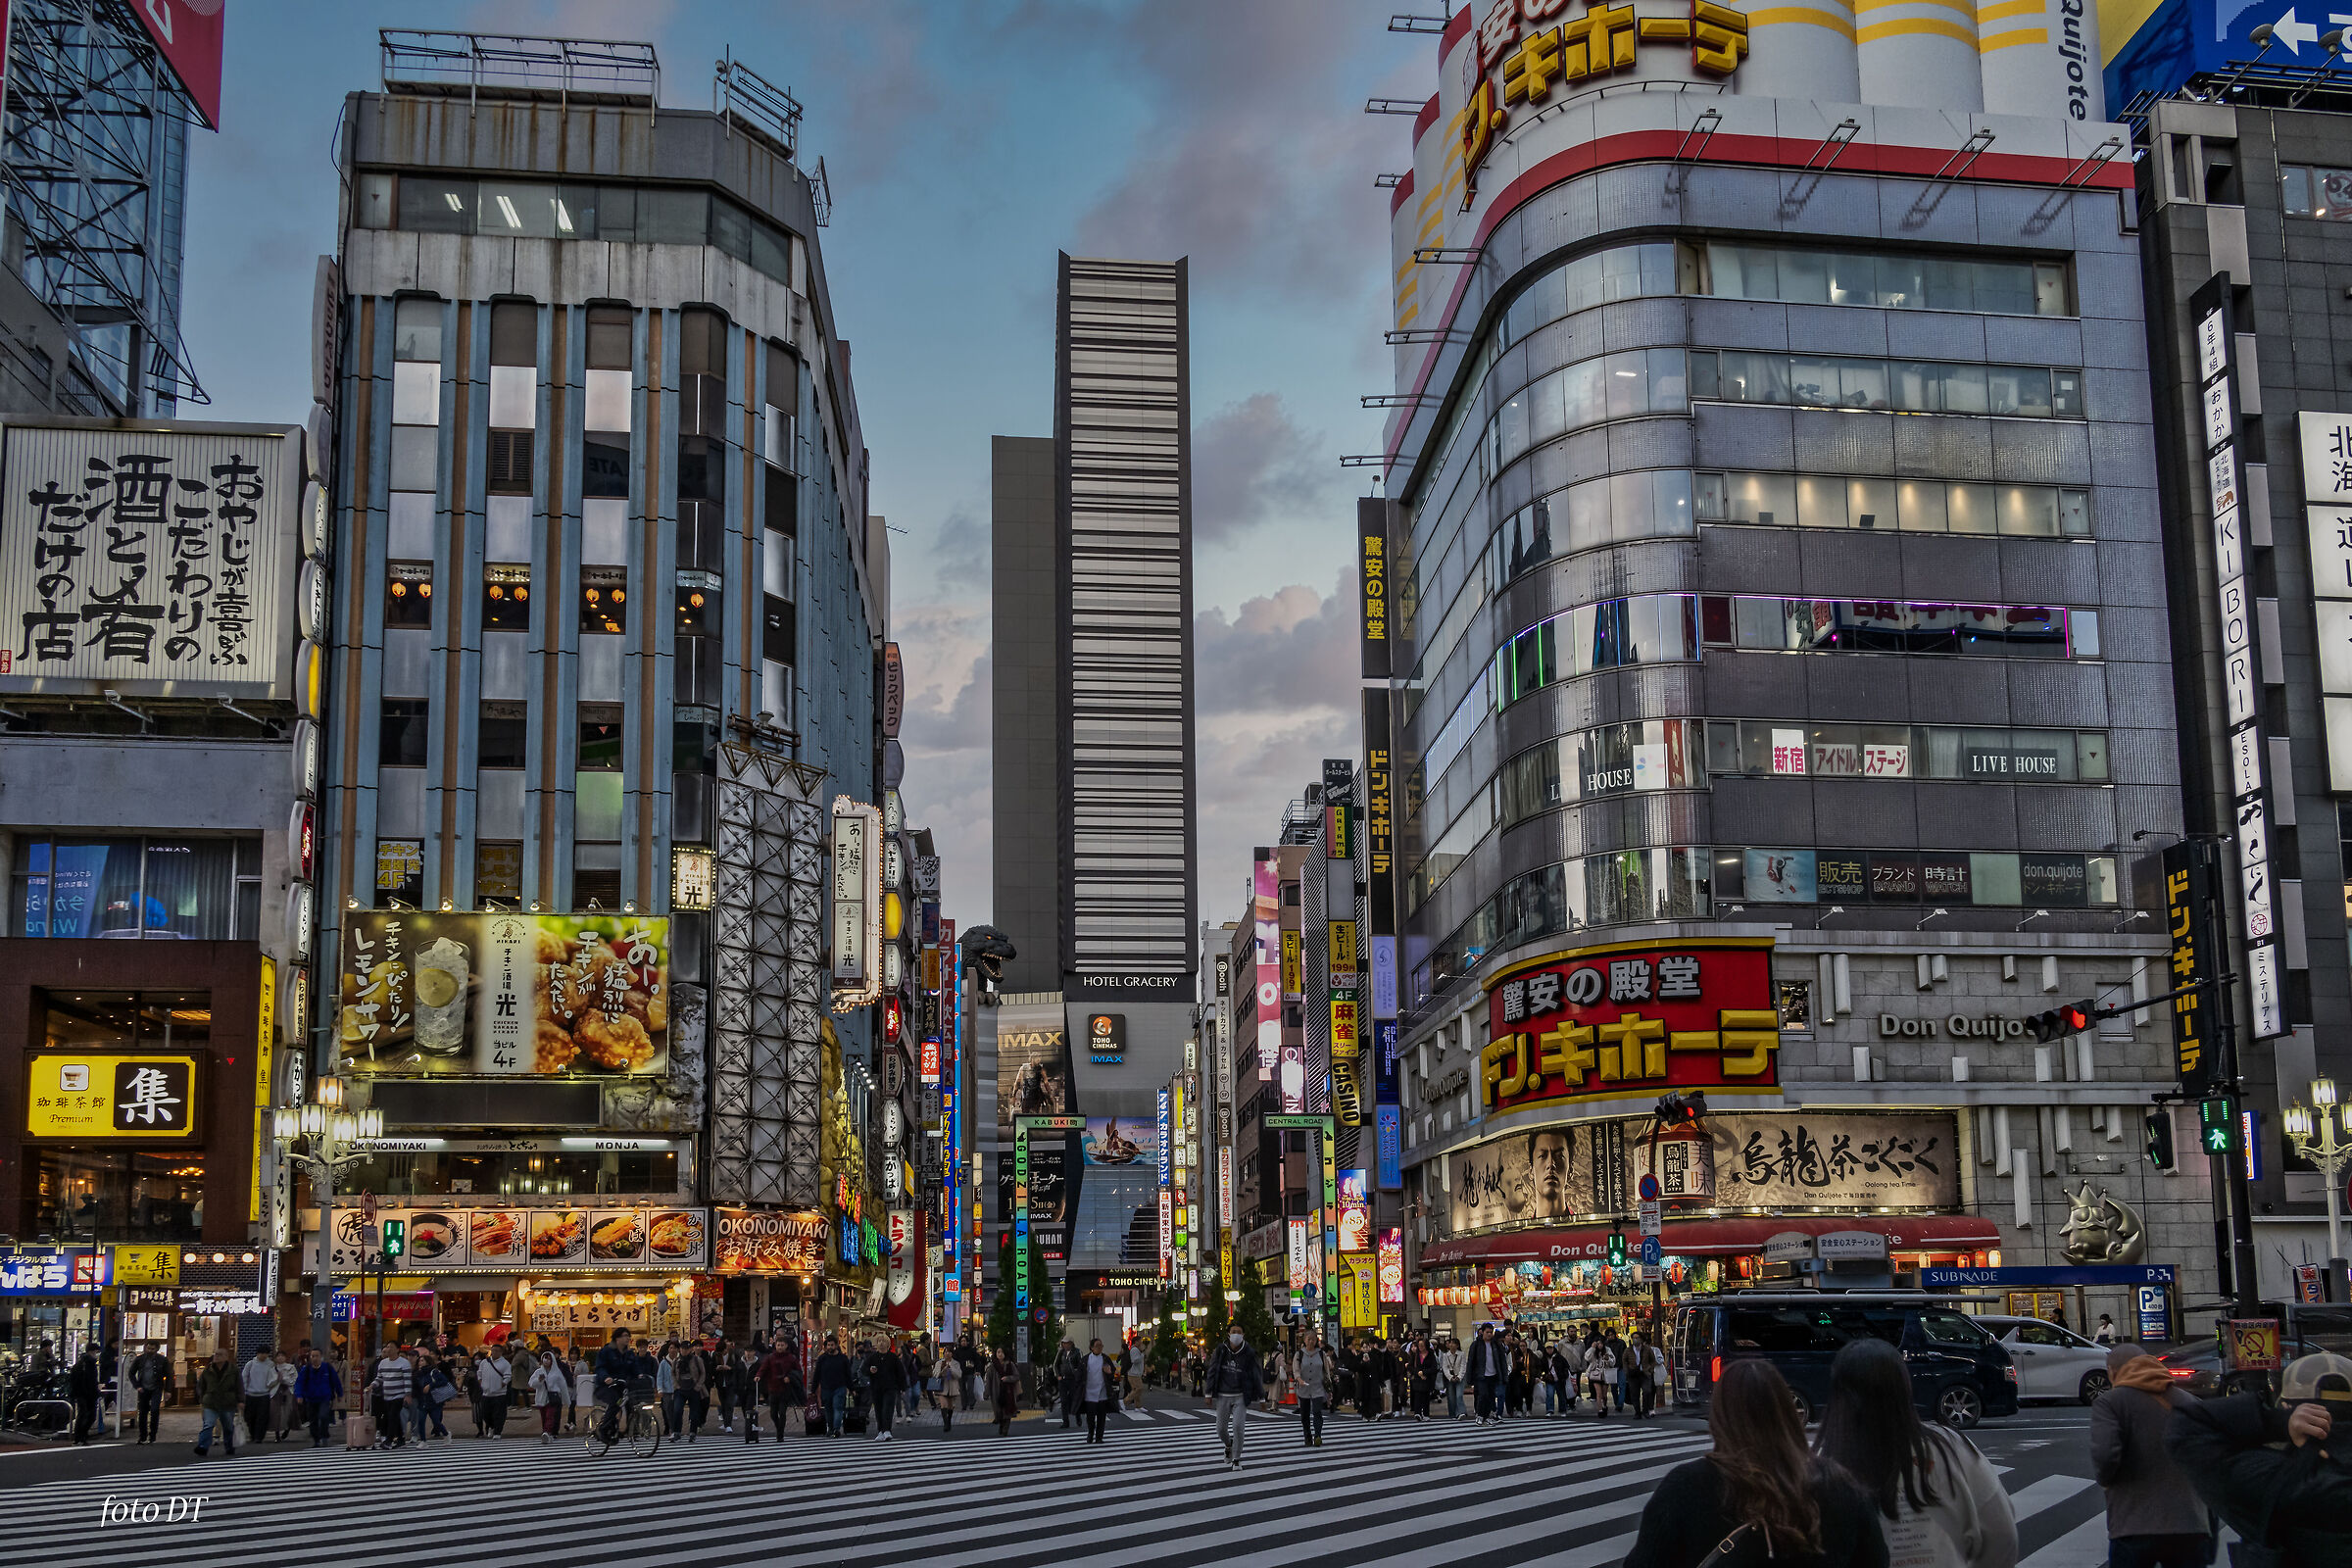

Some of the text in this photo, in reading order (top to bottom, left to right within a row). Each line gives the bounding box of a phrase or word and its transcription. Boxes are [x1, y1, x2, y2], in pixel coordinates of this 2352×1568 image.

[2206, 320, 2219, 371] 6年4組
[2211, 390, 2225, 439] おかか
[2220, 454, 2230, 489] 北海道
[80, 454, 173, 664] 酒と肴
[164, 477, 214, 662] こだわりの
[207, 454, 265, 666] おやじが喜ぶ
[15, 481, 90, 662] だけの店
[1364, 536, 1385, 640] 驚安の殿堂
[2220, 517, 2246, 712] KIBORI
[1773, 745, 1908, 775] 新宿 アイドル ステージ
[1973, 755, 2057, 774] LIVE HOUSE
[2240, 733, 2252, 792] ESOLA
[1587, 768, 1633, 793] HOUSE
[378, 843, 419, 857] チキン
[377, 872, 405, 888] 4F
[1819, 861, 1862, 884] 販売
[1872, 867, 1915, 881] ブランド
[1925, 867, 1967, 882] 時計
[2023, 862, 2083, 880] don.quijote
[685, 886, 702, 906] 光
[1873, 882, 1915, 893] BRAND
[1336, 924, 1345, 961] 生ビール
[502, 948, 512, 990] チキン酒場
[575, 931, 600, 996] チキンが
[842, 954, 855, 966] 光
[602, 962, 632, 1024] 猛烈に
[1084, 976, 1177, 987] HOTEL GRACERY
[1502, 956, 1701, 1022] 驚安の殿堂
[2258, 951, 2272, 1032] ミステリアス
[355, 927, 382, 1061] レモンサワー
[496, 993, 516, 1016] 光
[1335, 990, 1352, 1000] 4F
[1335, 1004, 1354, 1041] 麻雀
[1881, 1013, 2035, 1042] Don Quijo
[493, 1040, 517, 1049] 当ビル
[998, 1032, 1062, 1048] IMAX
[493, 1050, 516, 1068] 4F
[36, 1097, 107, 1108] 珈琲茶館
[119, 1067, 180, 1124] 集
[1333, 1062, 1359, 1122] CASINO
[49, 1113, 94, 1123] Premium
[1159, 1123, 1168, 1182] カラオケランド
[1690, 1141, 1712, 1194] 美味
[718, 1218, 829, 1239] OKONOMIYAKI
[1016, 1146, 1027, 1292] GODZILLA ROAD
[510, 1213, 524, 1256] うな丼
[891, 1214, 905, 1270] トラノコ
[1821, 1239, 1882, 1248] 安全安心ステーション
[723, 1238, 820, 1260] お好み焼き
[1550, 1243, 1642, 1256] Don Qute
[1644, 1244, 1653, 1261] P
[149, 1250, 176, 1280] 集
[1932, 1271, 1998, 1283] SUBNADE
[2146, 1269, 2154, 1280] P
[947, 1280, 959, 1292] 館
[392, 1300, 432, 1310] TAIYAKI
[2141, 1291, 2154, 1309] P
[569, 1306, 644, 1324] とらそば
